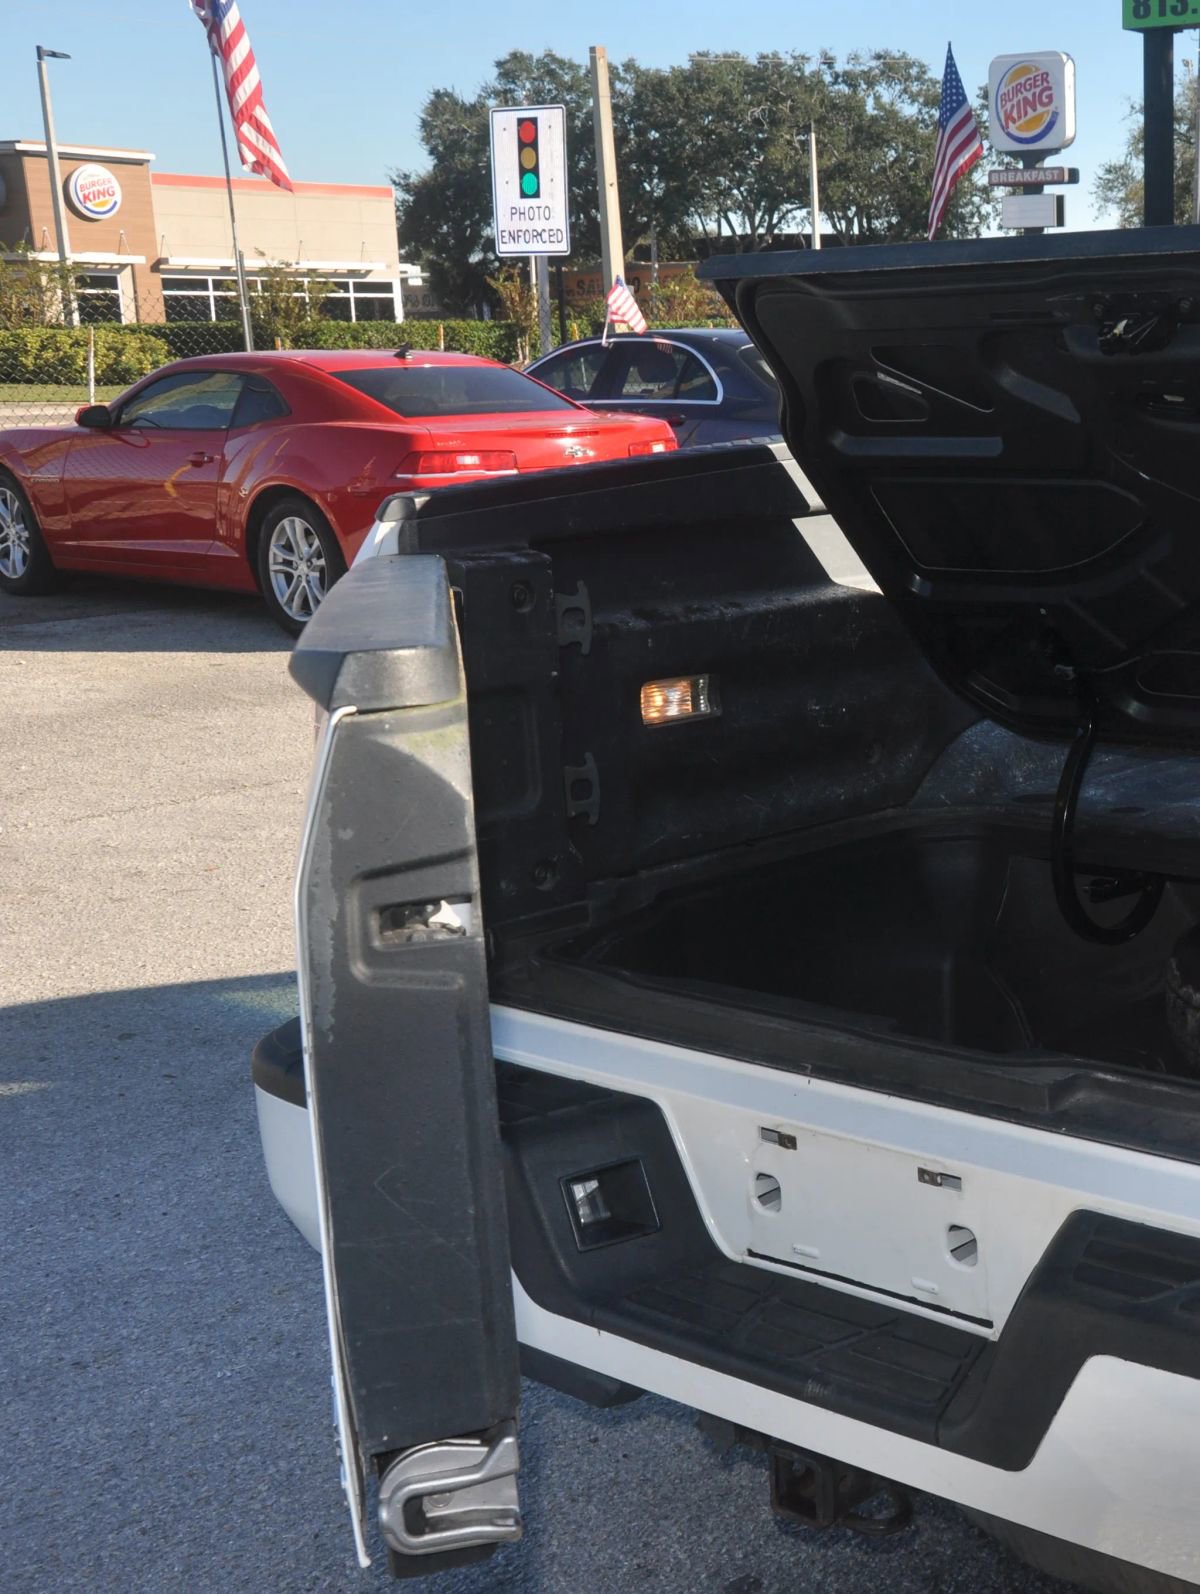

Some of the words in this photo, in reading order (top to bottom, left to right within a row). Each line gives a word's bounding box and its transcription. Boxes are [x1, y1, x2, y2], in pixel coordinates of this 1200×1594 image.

[1000, 71, 1050, 110] BURGER
[1003, 85, 1054, 130] KING
[991, 169, 1060, 183] BREAKFAST
[80, 178, 112, 192] BURGER
[83, 186, 115, 204] KING
[510, 205, 551, 221] PHOTO
[500, 228, 564, 244] ENFORCED
